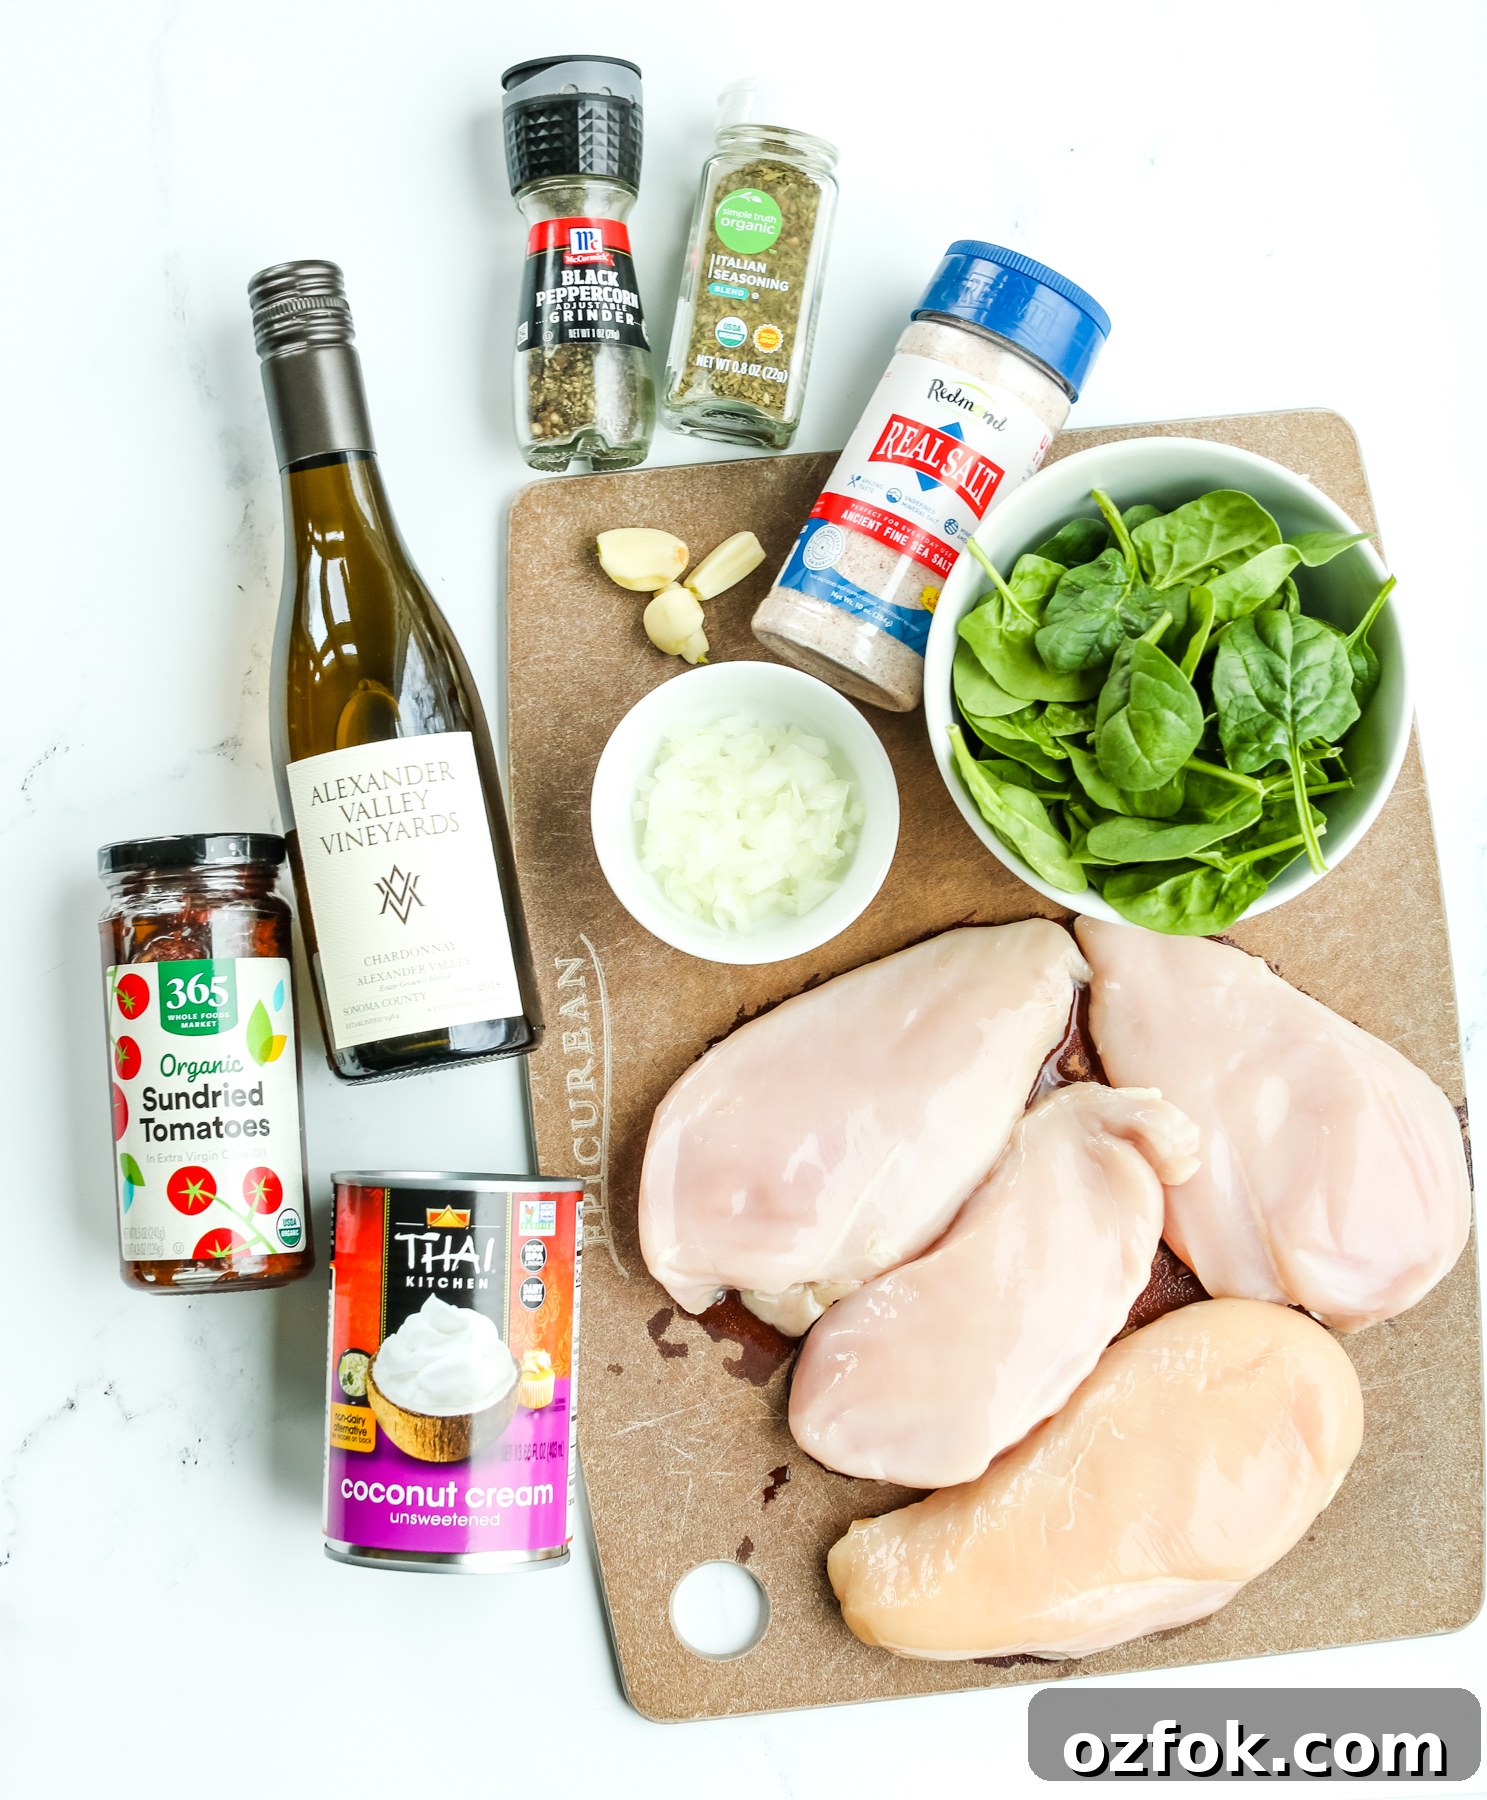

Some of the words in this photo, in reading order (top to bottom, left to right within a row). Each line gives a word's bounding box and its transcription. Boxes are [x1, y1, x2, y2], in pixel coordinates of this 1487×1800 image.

[723, 208, 752, 220] simple
[754, 212, 777, 224] truth
[721, 217, 776, 235] organic
[564, 253, 609, 263] McCormick
[716, 255, 767, 273] ITALIAN
[561, 269, 620, 287] BLACK
[713, 269, 789, 292] SEASONING
[536, 286, 639, 309] PEPPERCORN
[713, 285, 745, 297] BLEND
[555, 301, 628, 312] ADJUSTABLE
[549, 309, 634, 325] GRINDER
[569, 329, 580, 338] NET
[723, 322, 741, 332] USDA
[696, 354, 715, 369] NET
[716, 357, 731, 373] WT
[732, 361, 748, 375] 0.8
[749, 364, 762, 377] OZ
[762, 366, 788, 384] (22g)
[927, 378, 1008, 432] Redmond
[876, 420, 945, 469] REAL
[940, 448, 999, 507] SALT
[861, 477, 884, 490] AMAZING
[901, 501, 926, 518] MINERAL
[904, 494, 938, 514] UNREFINED
[851, 503, 882, 519] PERFECT
[883, 514, 899, 527] FOR
[901, 525, 939, 550] EVERYDAY
[940, 547, 953, 559] USE
[841, 509, 883, 532] ANCIENT
[883, 526, 909, 547] FINE
[910, 540, 930, 559] SEA
[931, 552, 953, 573] SALT
[830, 590, 842, 600] Net
[842, 596, 854, 606] Wt.
[854, 601, 863, 609] 10
[311, 761, 455, 806] ALEXANDER
[339, 789, 429, 823] VALLEY
[320, 812, 460, 855] VINEYARDS
[363, 940, 457, 967] CHARDONNAY
[356, 963, 425, 986] ALEXANDER
[428, 956, 472, 971] VALLEY
[166, 972, 229, 1010] 365
[343, 1001, 380, 1016] SONOMA
[381, 991, 427, 1008] COUNTY
[167, 1013, 198, 1021] WHOLE
[200, 1012, 230, 1020] FOODS
[181, 1020, 217, 1029] MARKET
[160, 1053, 244, 1083] Organic
[142, 1081, 264, 1112] Sundried
[554, 956, 610, 1248] EPICUREAN
[139, 1116, 271, 1143] Tomatoes
[146, 1154, 156, 1164] In
[157, 1152, 183, 1164] Extra
[185, 1150, 219, 1165] Virgin
[252, 1147, 267, 1159] Oil
[282, 1218, 298, 1227] USDA
[280, 1228, 300, 1238] ORGANIC
[394, 1232, 495, 1274] THAI
[525, 1245, 544, 1253] NON
[525, 1252, 544, 1261] BPA
[405, 1275, 489, 1290] KITCHEN
[523, 1283, 543, 1294] DAIRY
[335, 1413, 366, 1427] non-dairy
[540, 1442, 547, 1460] OZ
[341, 1478, 458, 1507] coconut
[465, 1483, 553, 1508] cream
[390, 1511, 501, 1527] unsweetened
